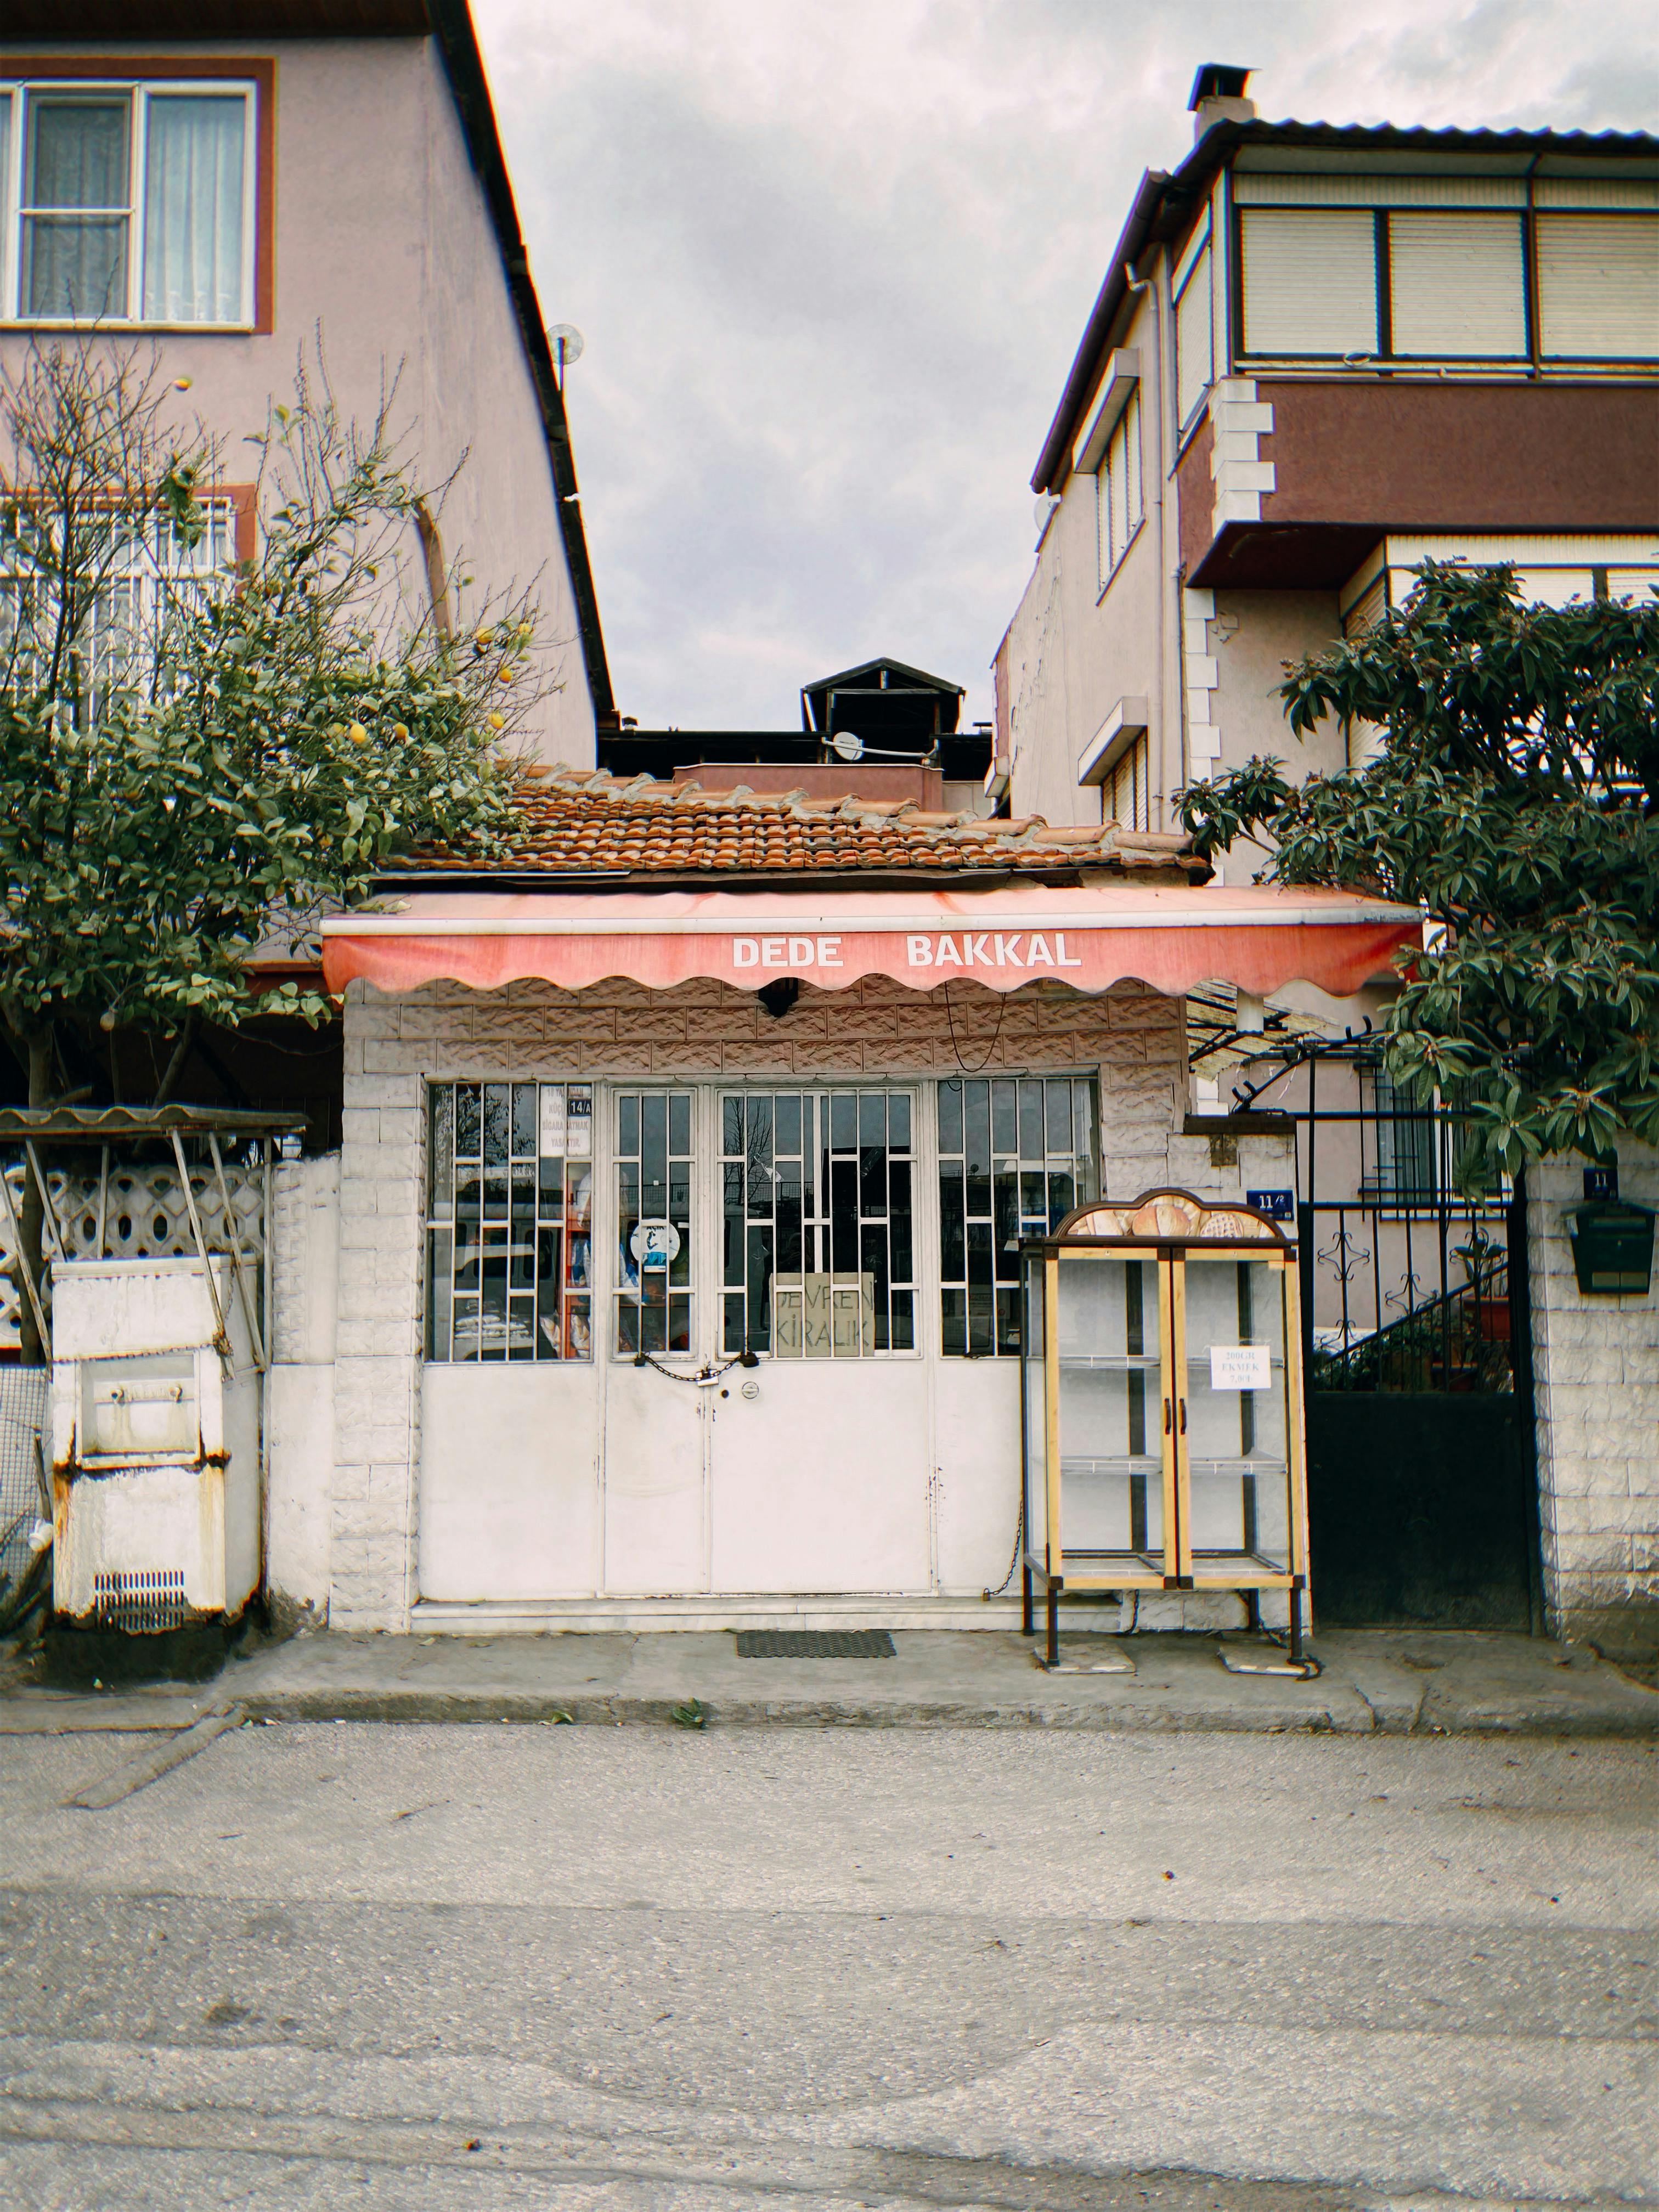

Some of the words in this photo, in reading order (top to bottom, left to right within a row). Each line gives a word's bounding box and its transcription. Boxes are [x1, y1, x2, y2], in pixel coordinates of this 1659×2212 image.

[732, 936, 844, 967] DEDE
[906, 933, 1082, 967] BAKKAL
[571, 1100, 591, 1114] 14/A
[542, 1120, 563, 1130] SİGARA
[566, 1120, 588, 1130] ATMAK
[1594, 1172, 1608, 1187] 11
[776, 1314, 870, 1348] KİRALIK
[1225, 1351, 1255, 1360] 200GR
[1222, 1363, 1259, 1372] EKMEK
